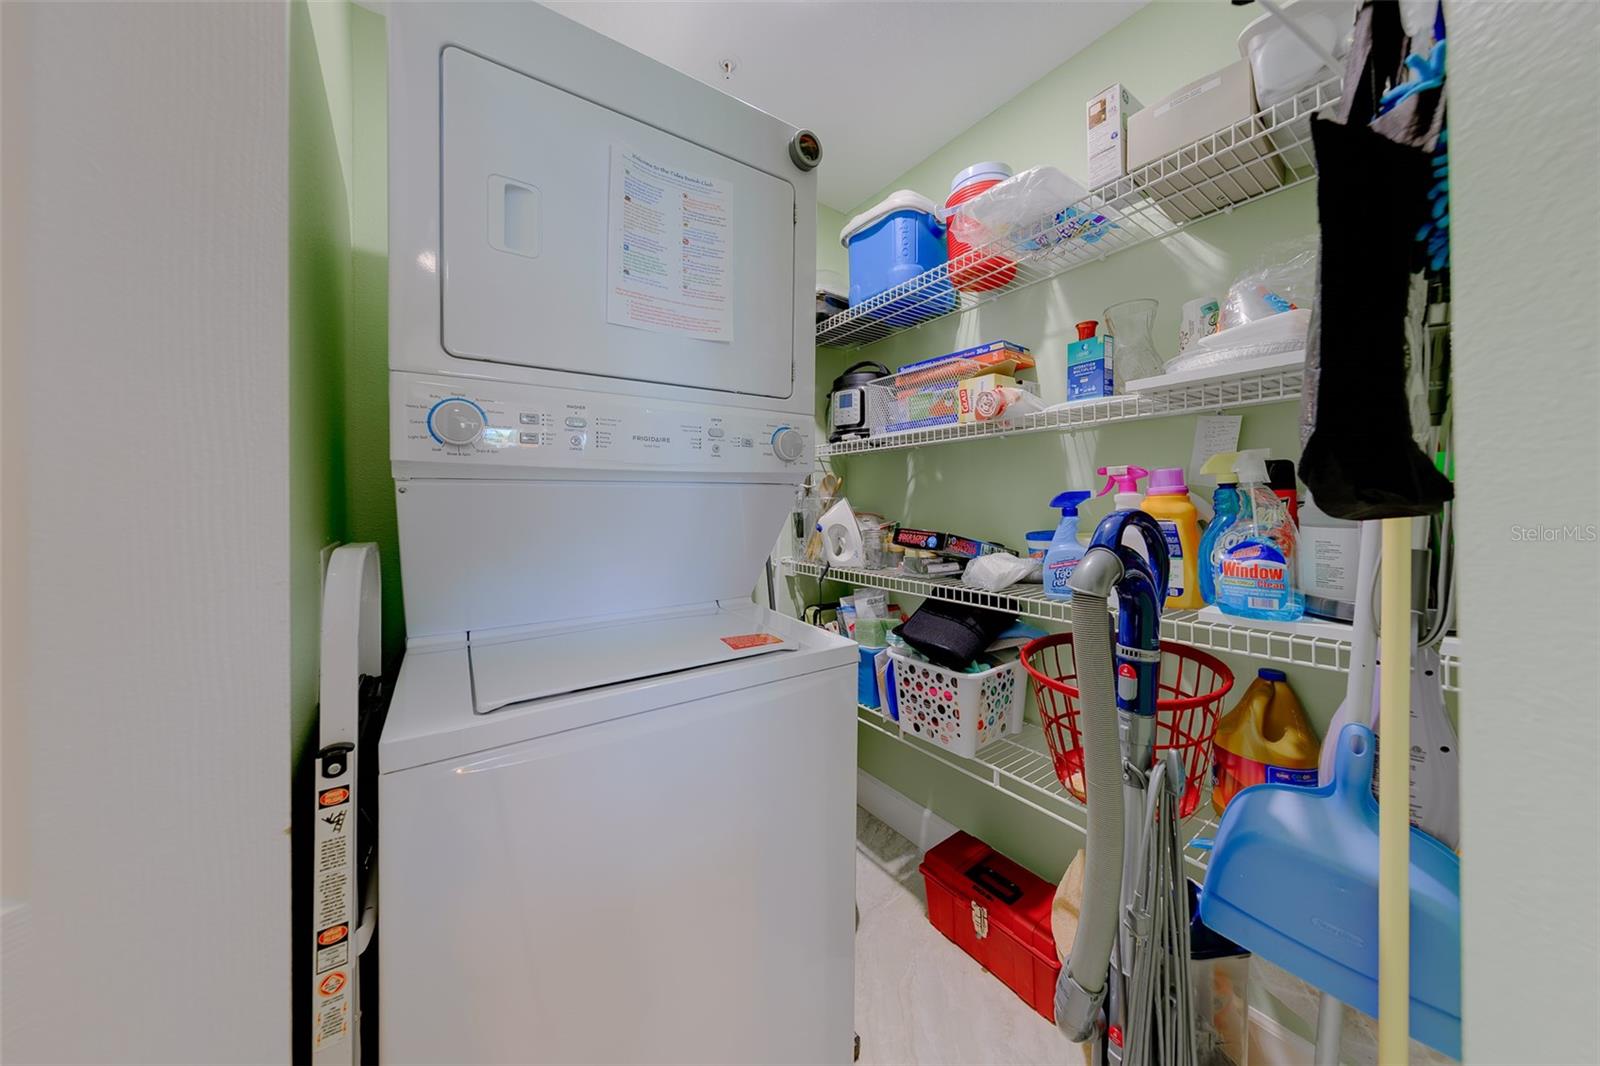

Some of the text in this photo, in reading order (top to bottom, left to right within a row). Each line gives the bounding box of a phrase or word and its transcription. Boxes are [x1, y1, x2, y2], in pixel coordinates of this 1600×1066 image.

[960, 390, 969, 412] GLAD
[632, 435, 671, 444] FRIGIDAIRE
[1055, 567, 1073, 579] fab
[1223, 560, 1283, 580] Window
[1257, 580, 1285, 590] Clean
